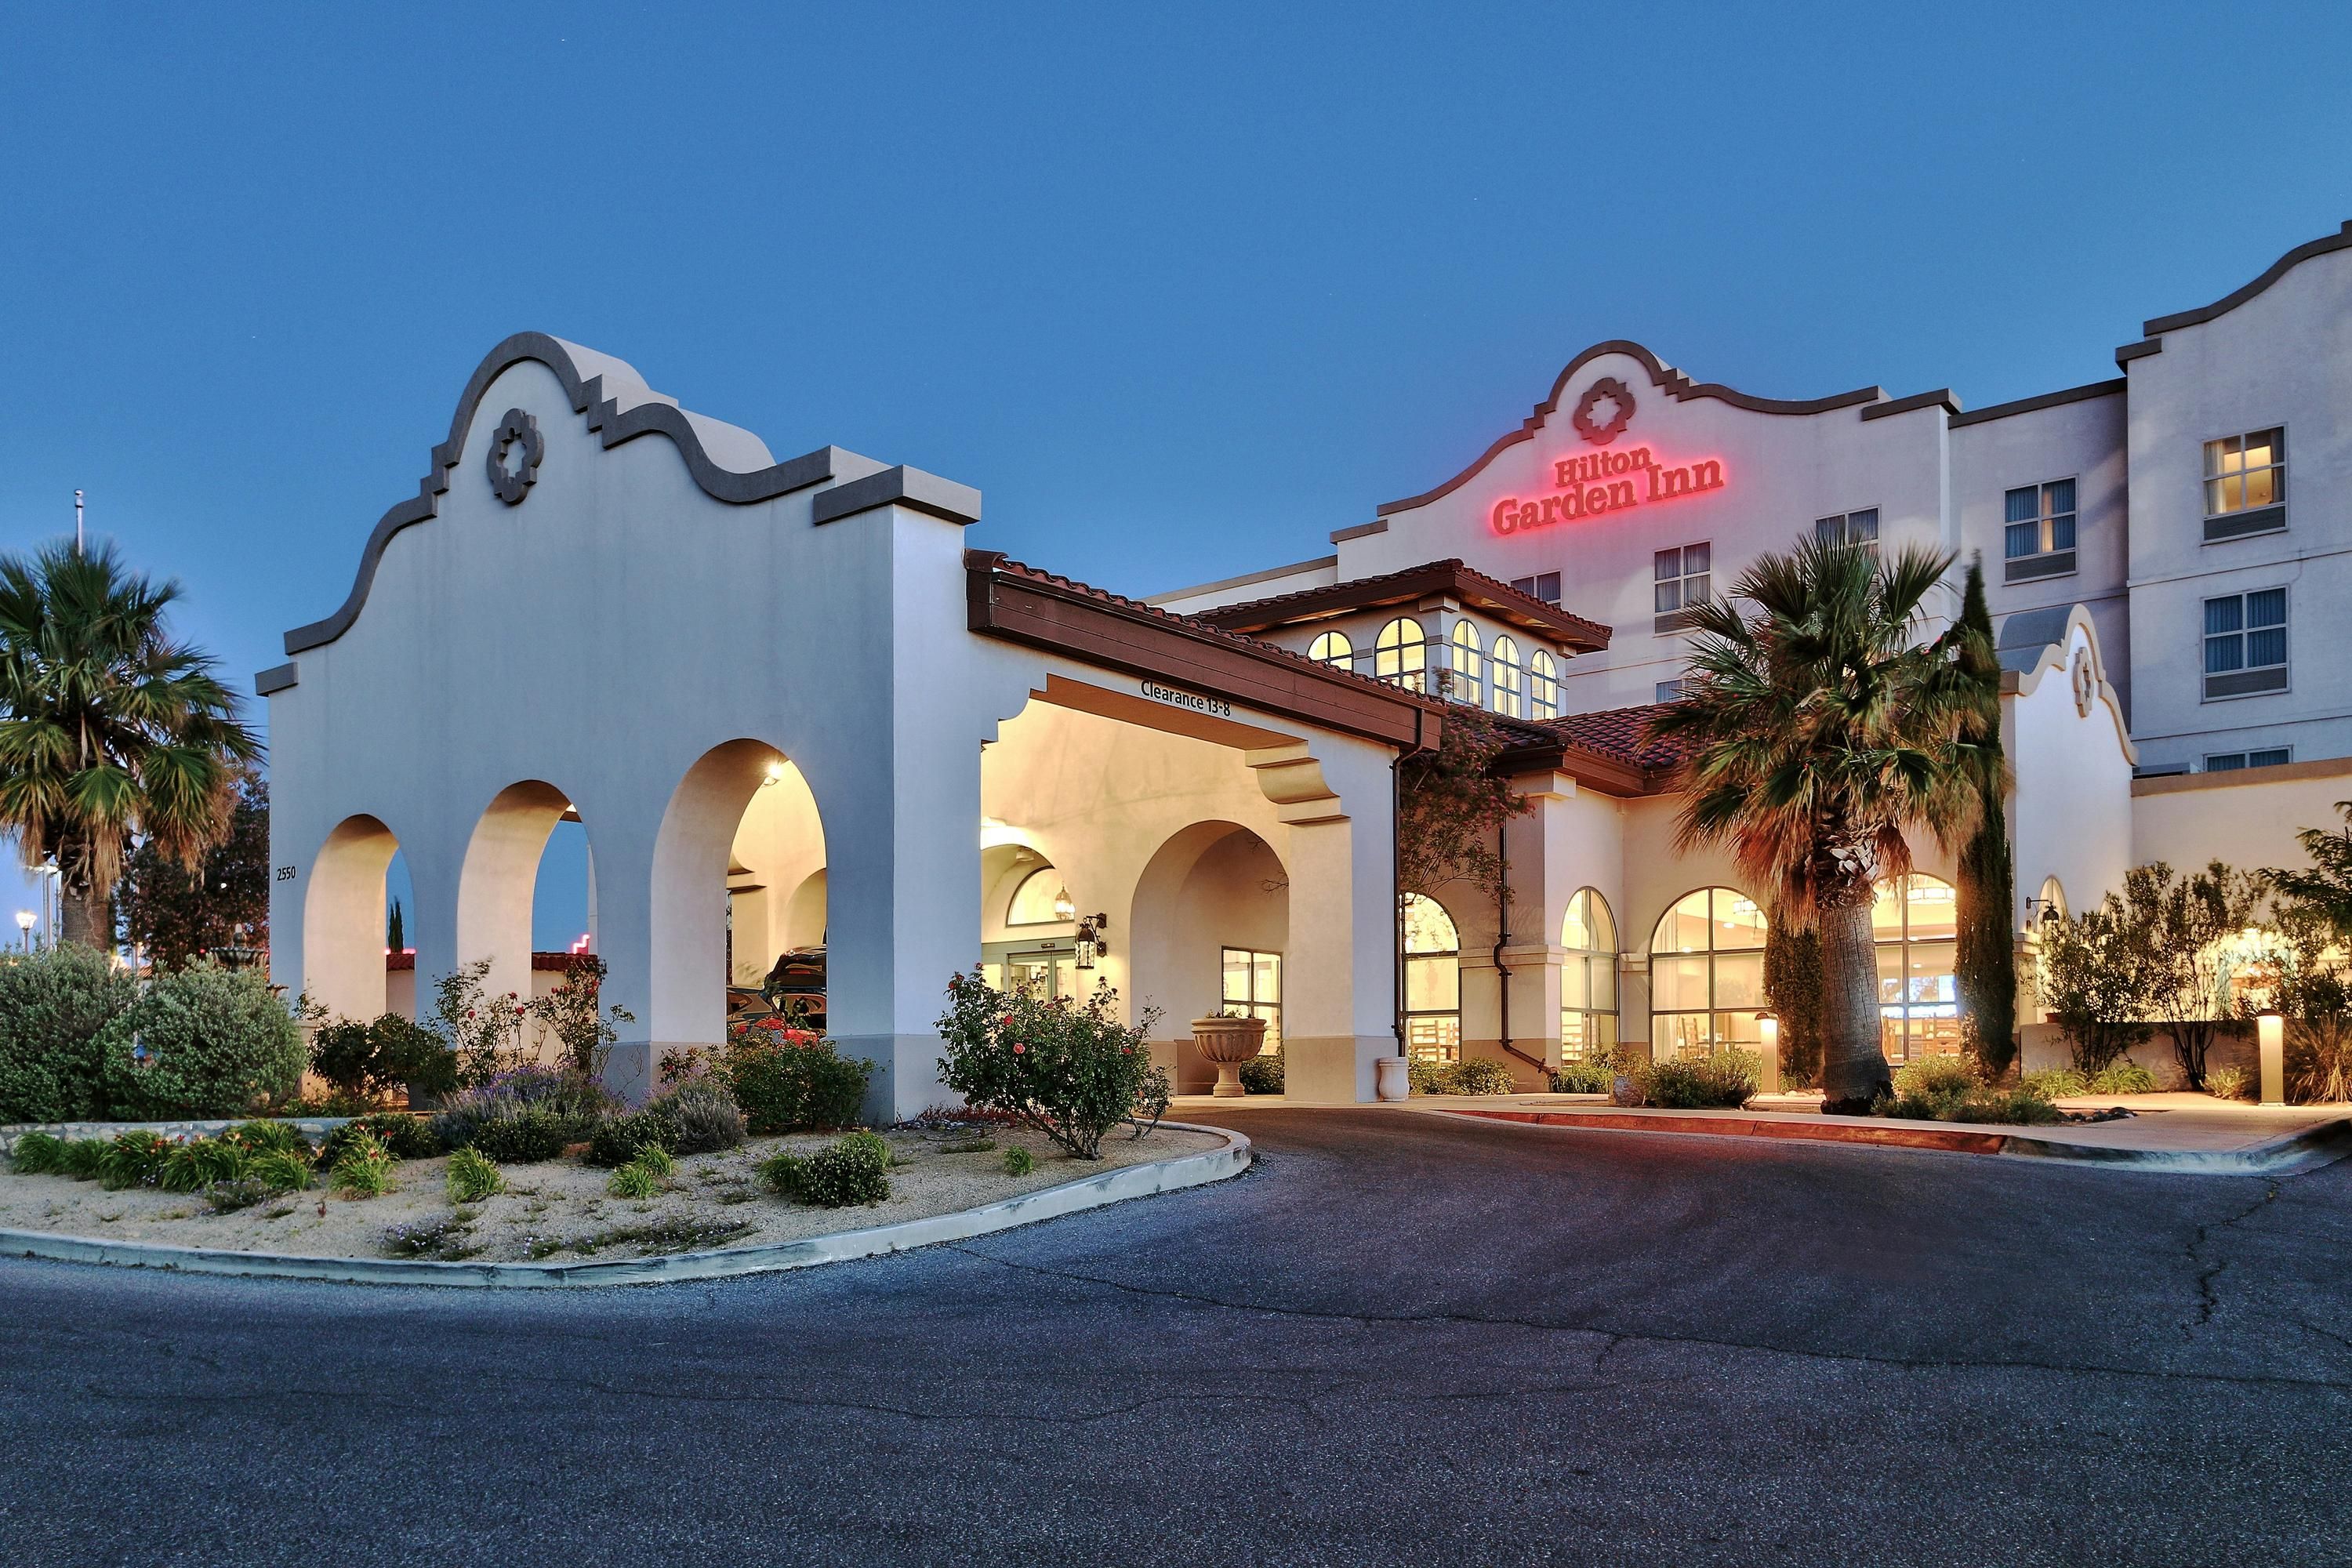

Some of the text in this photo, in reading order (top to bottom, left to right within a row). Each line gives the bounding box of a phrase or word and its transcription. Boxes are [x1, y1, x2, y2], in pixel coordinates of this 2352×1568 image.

[1555, 447, 1653, 488] Hilton
[1493, 459, 1724, 535] Garden Inn
[1141, 679, 1231, 717] Clearance 13-8
[277, 866, 296, 881] 2550
